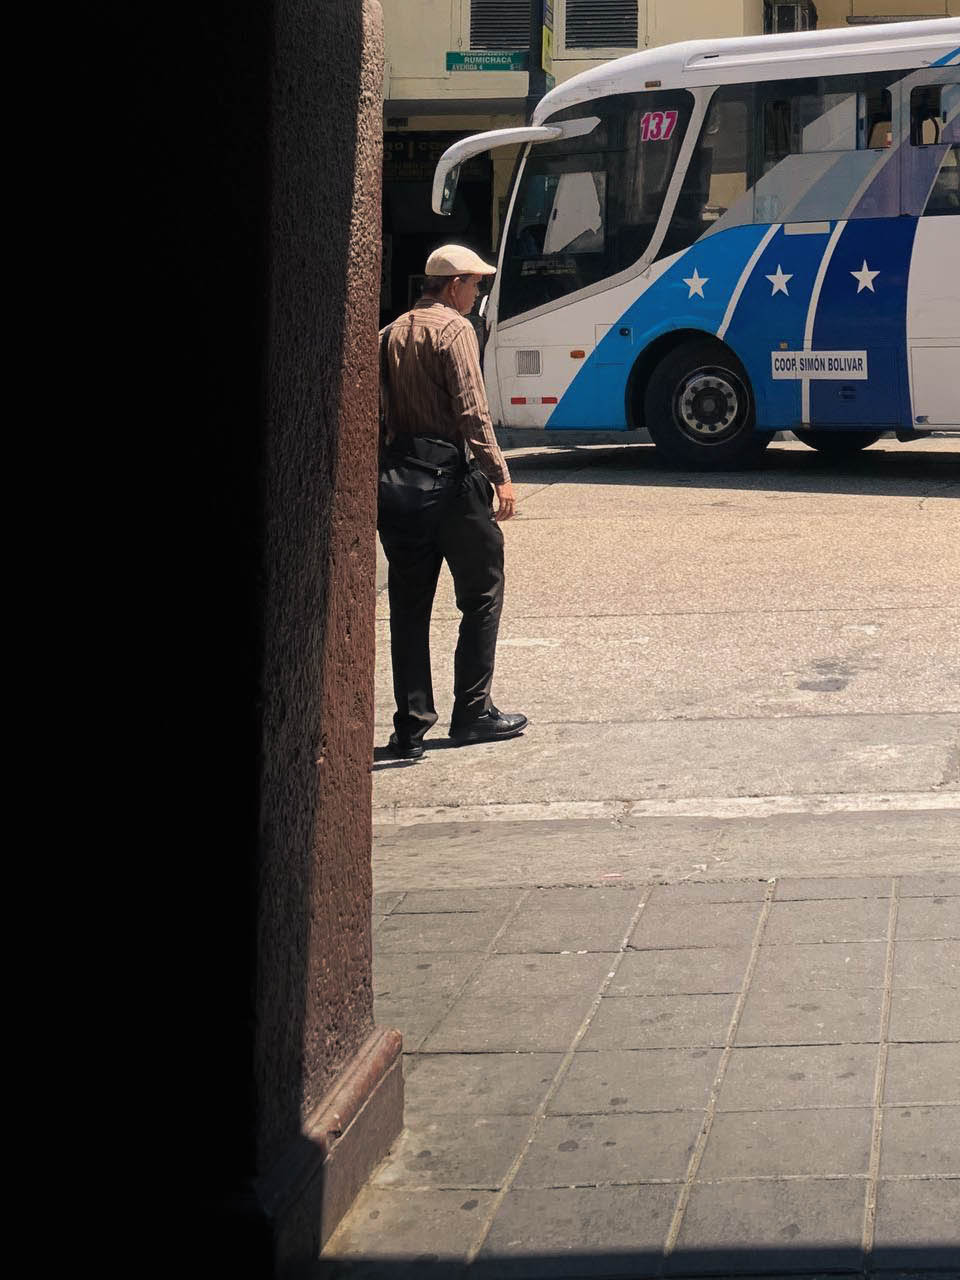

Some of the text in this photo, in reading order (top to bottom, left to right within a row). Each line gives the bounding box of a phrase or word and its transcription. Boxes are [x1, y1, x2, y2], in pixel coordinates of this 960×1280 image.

[464, 56, 512, 64] RUMICHACA
[640, 110, 679, 141] 137
[827, 358, 863, 371] BOLIVAR
